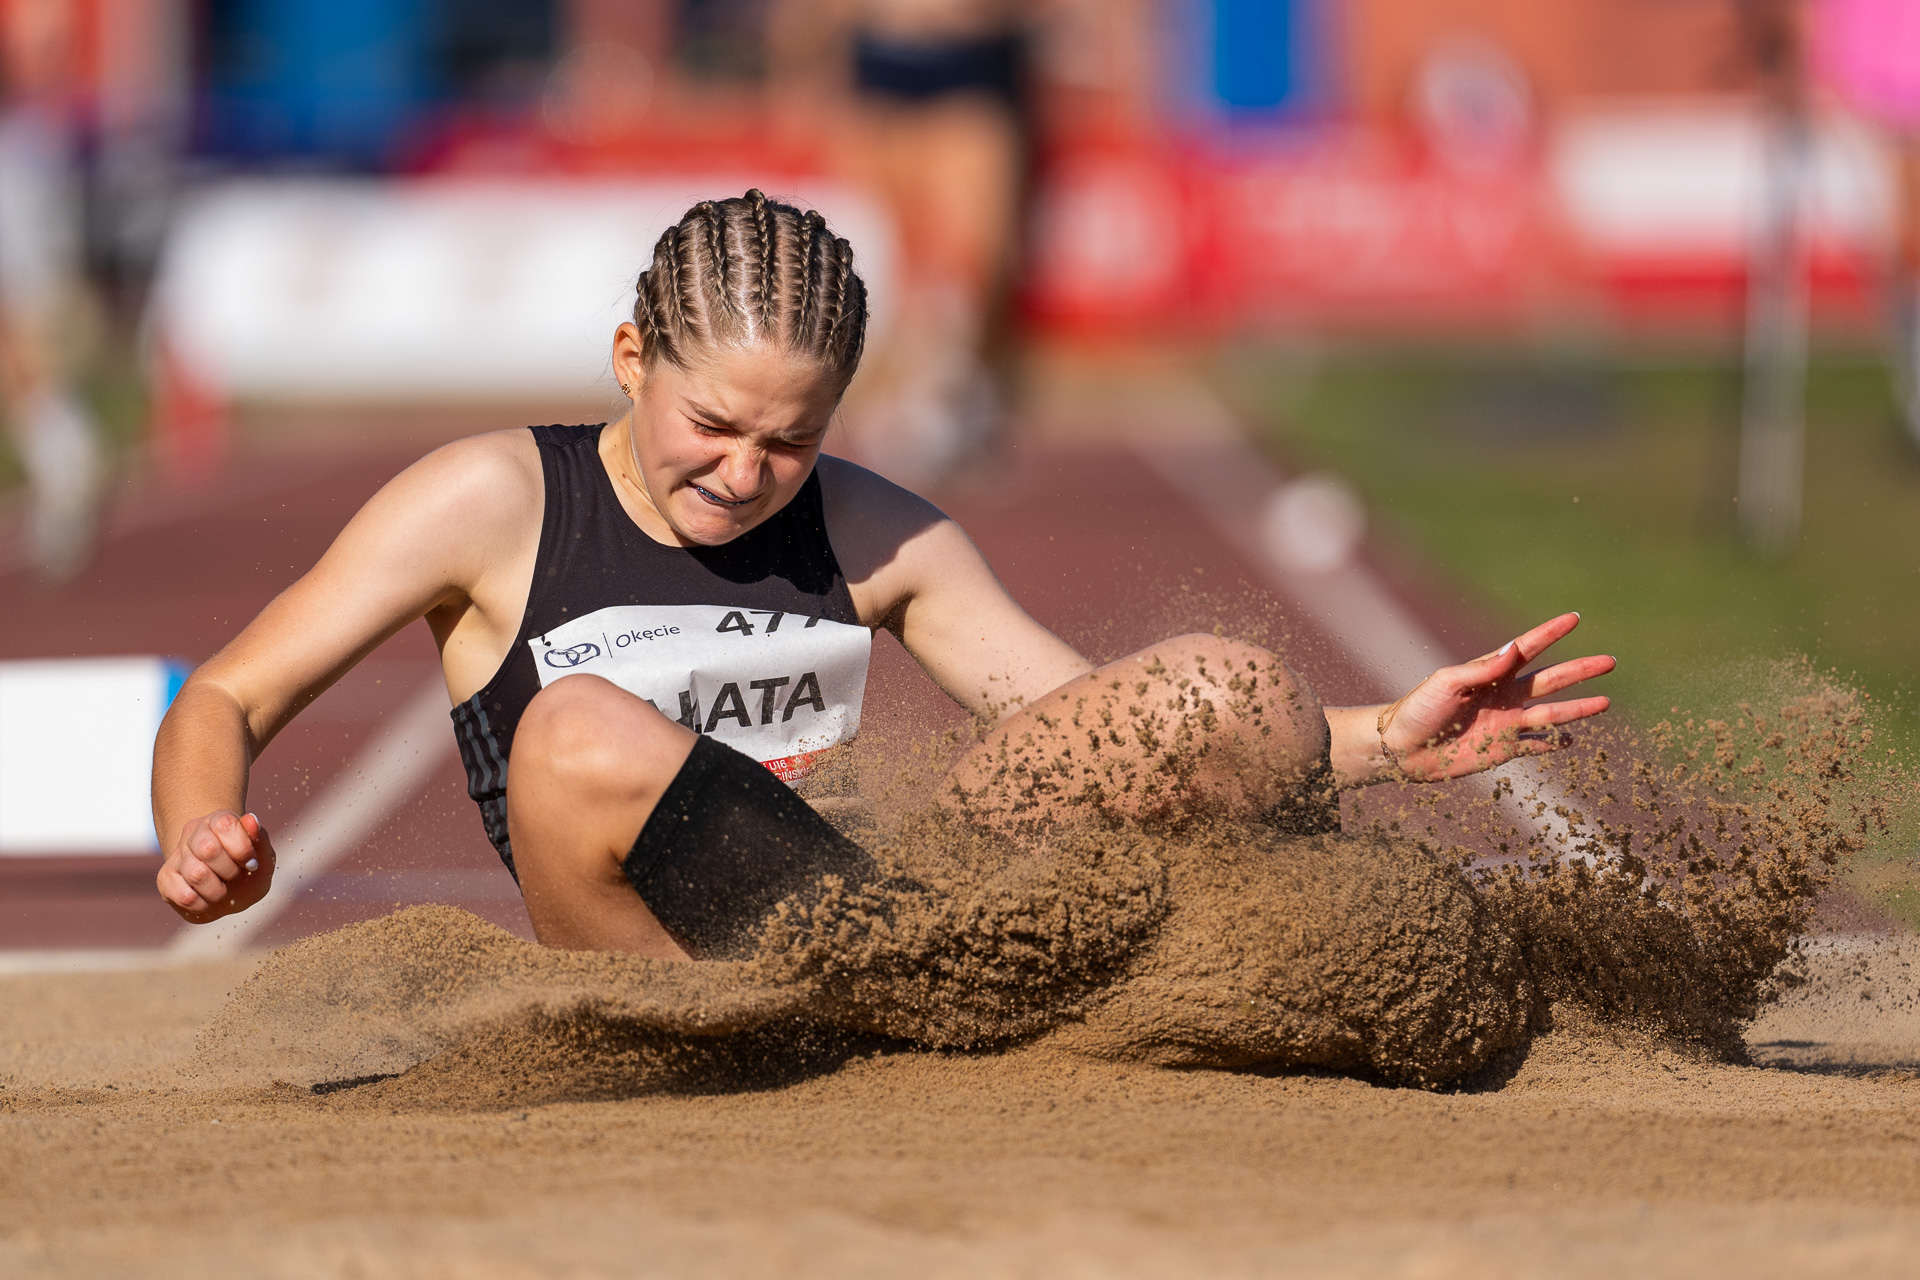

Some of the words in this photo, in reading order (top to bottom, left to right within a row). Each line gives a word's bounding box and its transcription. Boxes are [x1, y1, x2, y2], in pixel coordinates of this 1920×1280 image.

[616, 624, 681, 648] Okęcie
[645, 671, 826, 734] ŁATA
[768, 759, 787, 771] U16
